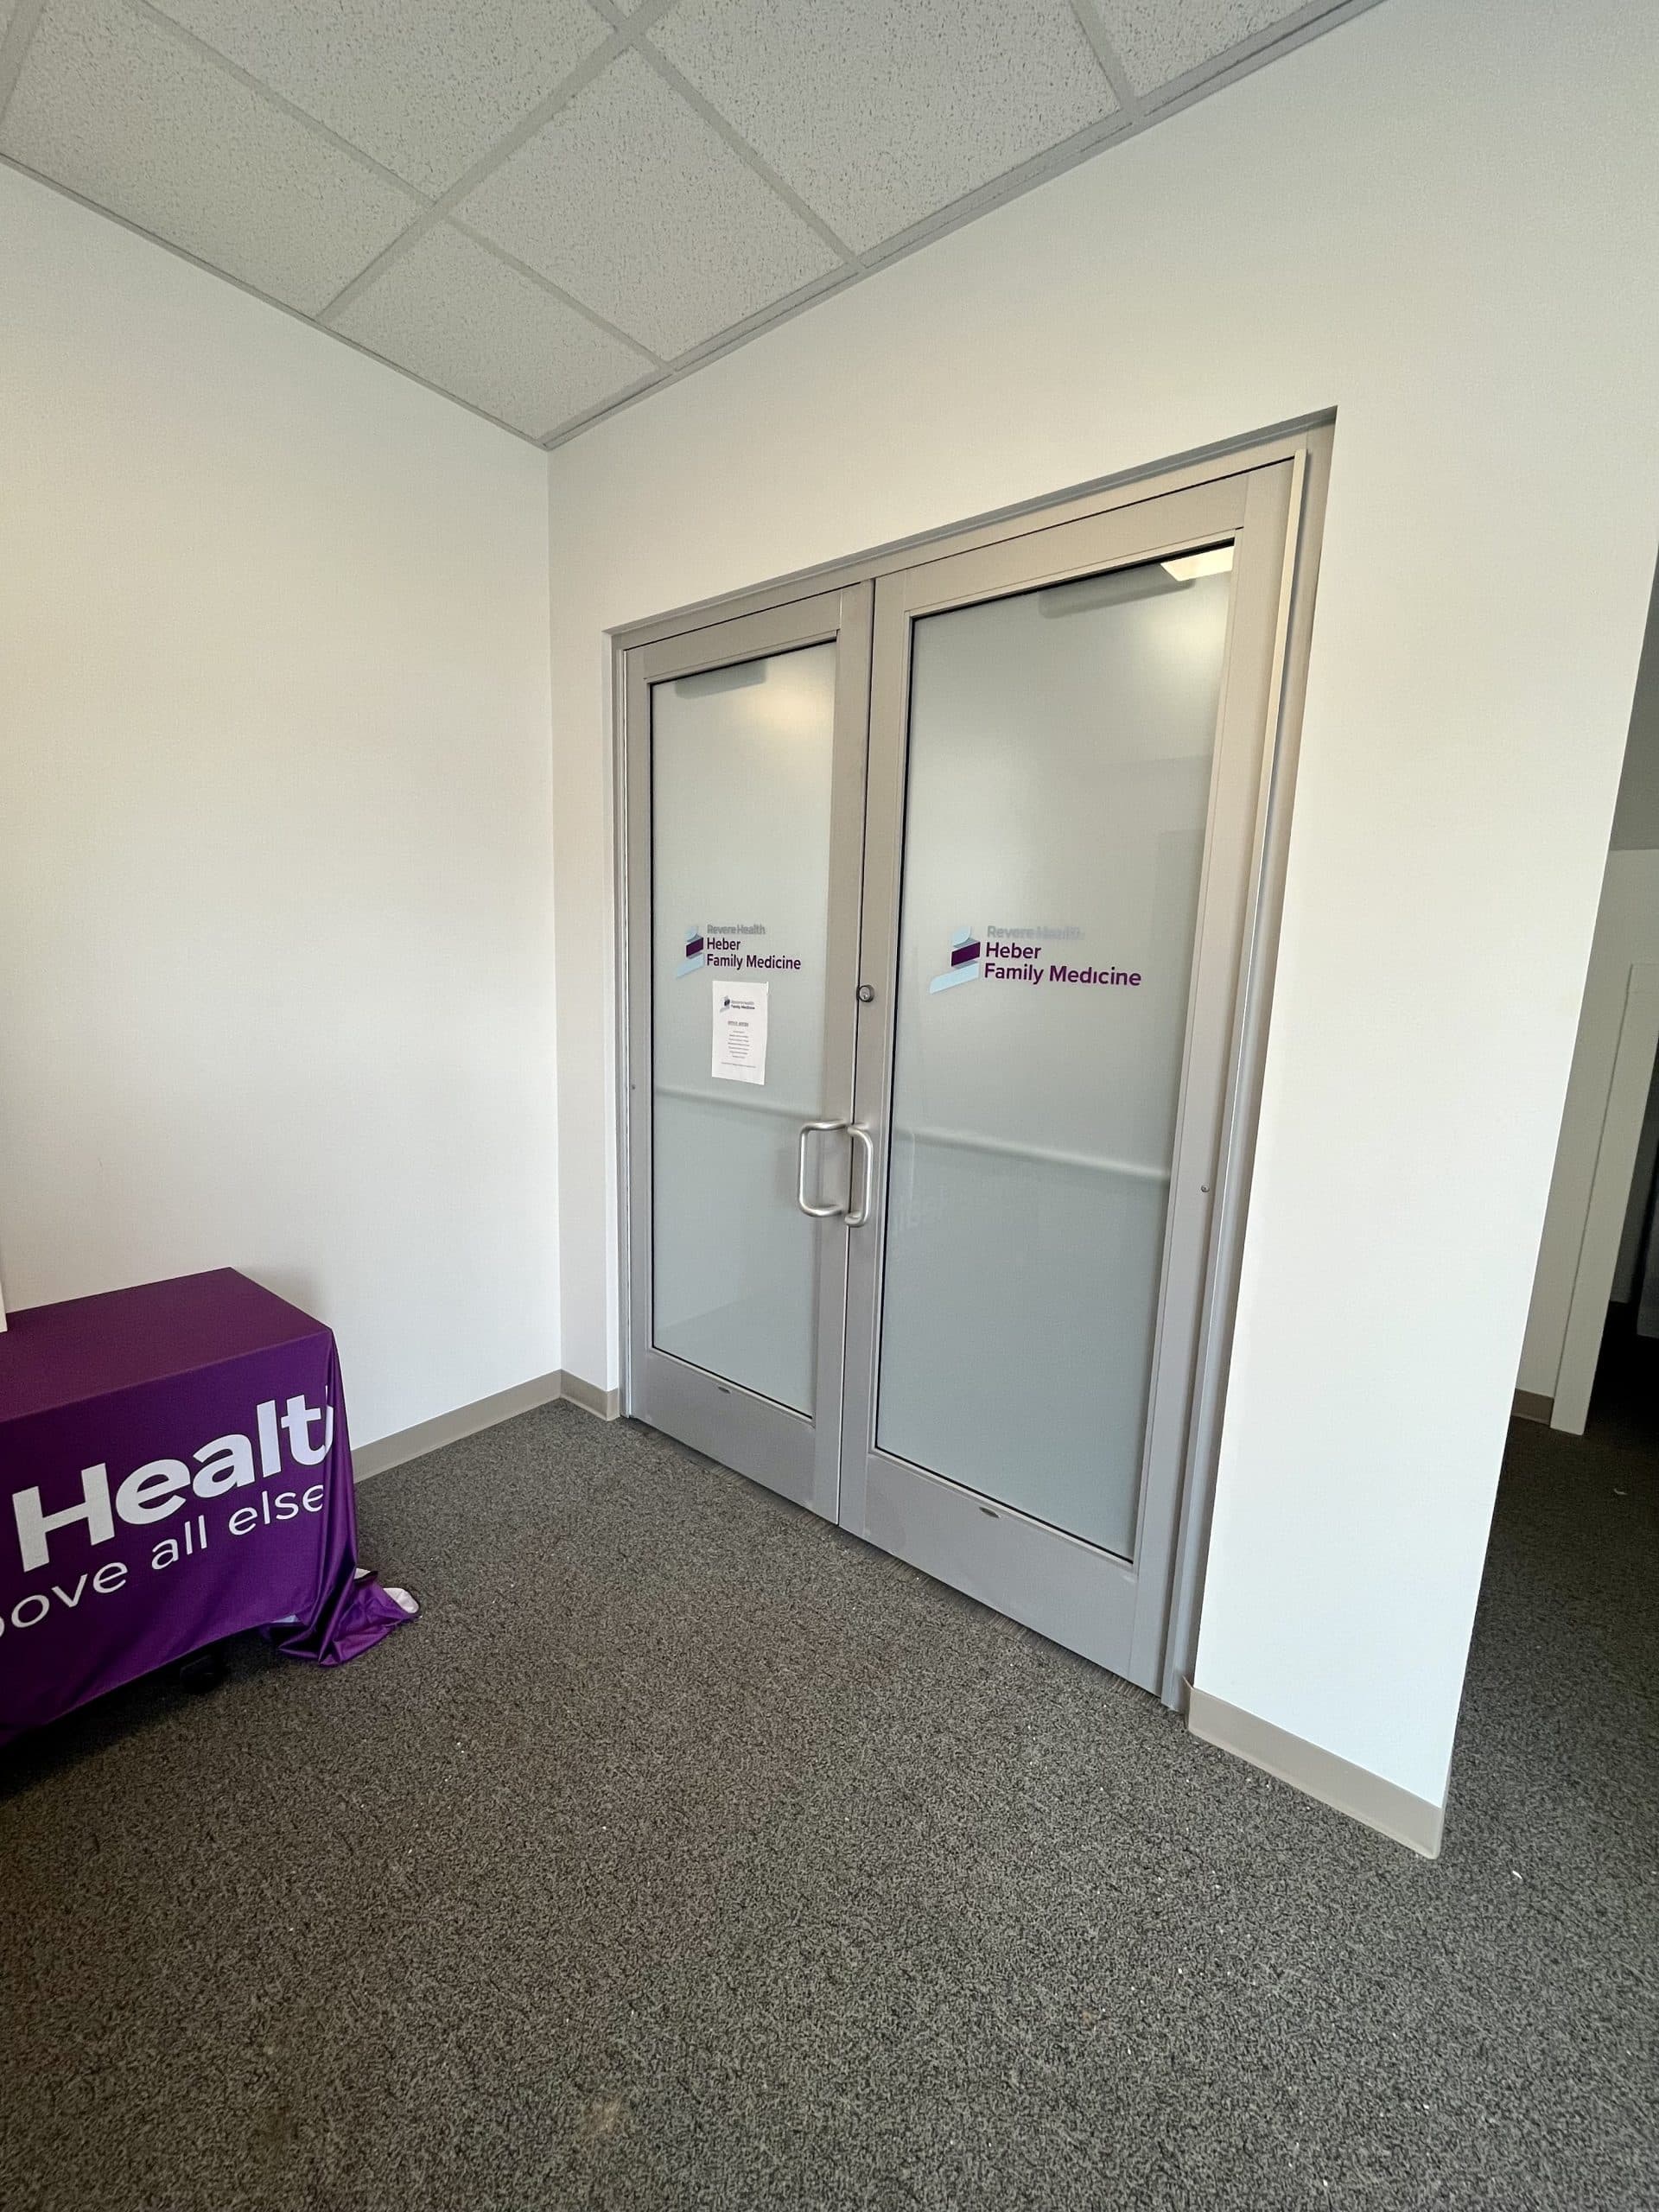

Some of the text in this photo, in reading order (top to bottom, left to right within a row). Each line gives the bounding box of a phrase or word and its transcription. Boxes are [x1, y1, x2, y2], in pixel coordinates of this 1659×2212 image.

[707, 938, 741, 950] Heber
[986, 942, 1041, 959] Heber
[707, 953, 801, 970] Family Medicine
[984, 963, 1141, 986] Family Medicine
[12, 1385, 334, 1573] Healt
[0, 1484, 324, 1638] ove all else
